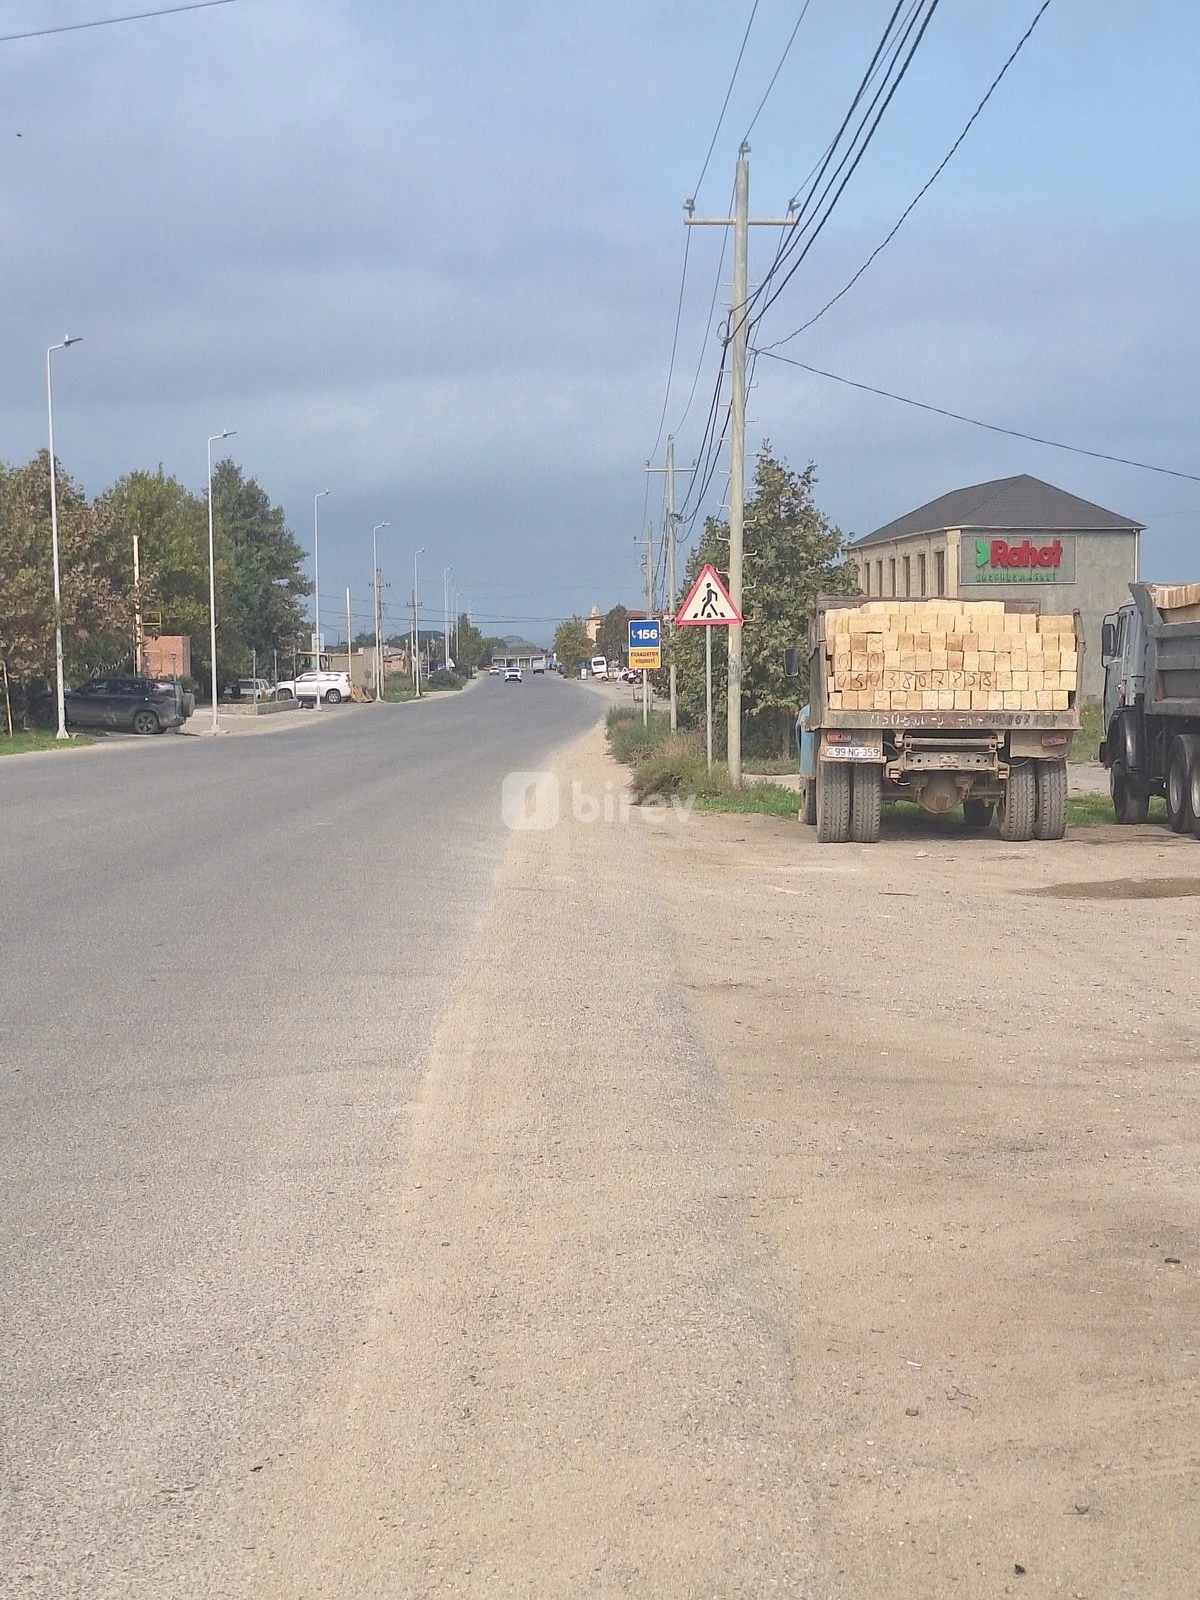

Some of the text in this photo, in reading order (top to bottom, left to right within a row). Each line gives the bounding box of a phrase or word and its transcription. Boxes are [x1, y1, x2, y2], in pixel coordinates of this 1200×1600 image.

[990, 538, 1063, 567] Rahat
[637, 629, 658, 640] 156
[834, 747, 846, 757] 99
